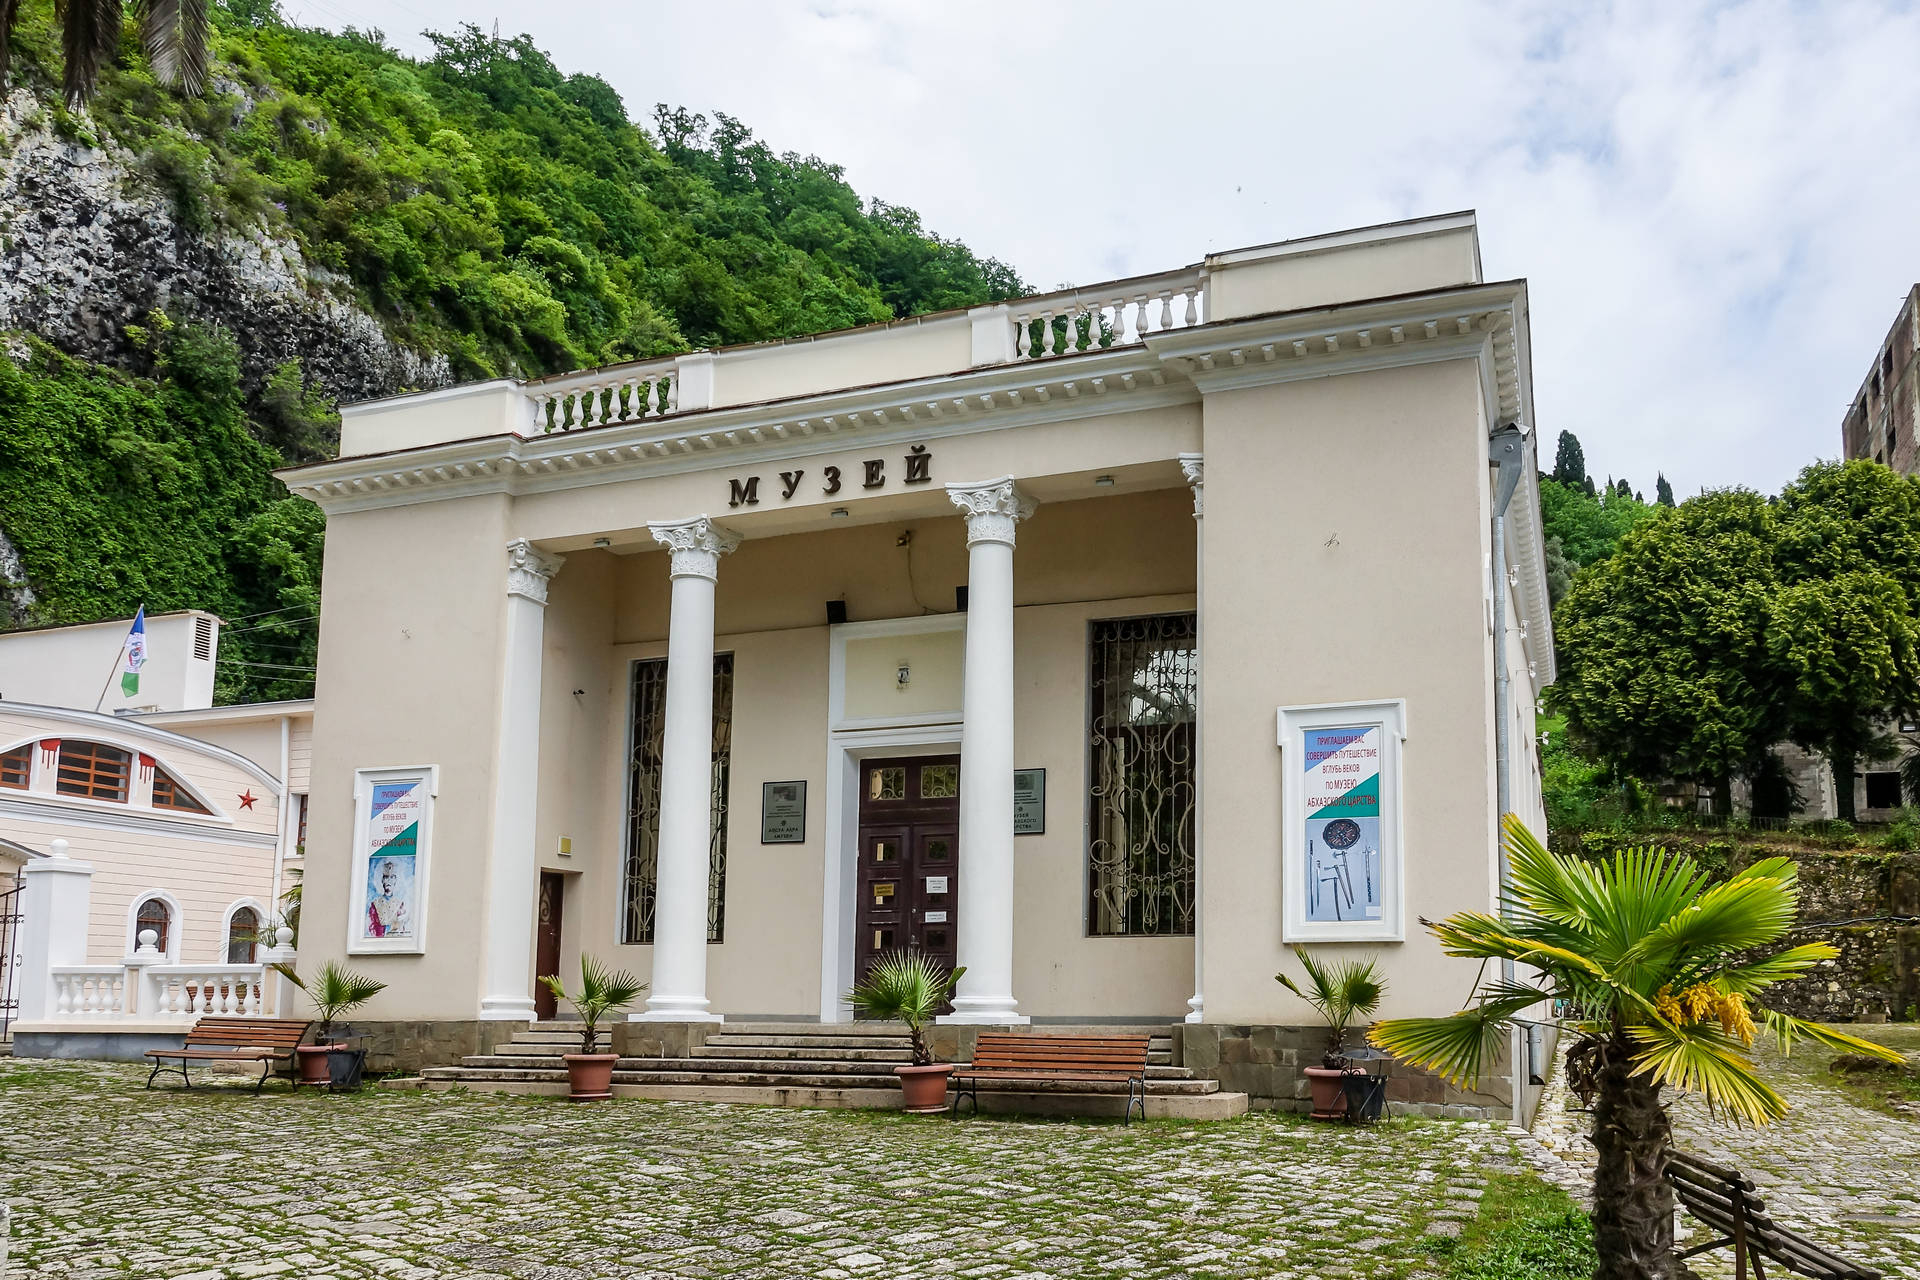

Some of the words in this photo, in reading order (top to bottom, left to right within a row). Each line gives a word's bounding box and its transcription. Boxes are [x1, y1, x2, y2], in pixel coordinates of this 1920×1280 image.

[728, 444, 932, 508] МУЗЕЙ
[1317, 736, 1353, 745] ПРИГЛАШАЕМ
[1354, 735, 1365, 743] ВАС
[1306, 750, 1338, 760] СОВЕРШИТЬ
[1339, 749, 1377, 759] ПУТЕШЕСТВИЕ
[1322, 765, 1342, 774] ВГЛУБЬ
[1343, 764, 1360, 773] ВЕКОВ
[1334, 779, 1357, 790] МУЗЕЮ
[1307, 796, 1347, 807] АБХАЗСКОГО
[1348, 795, 1377, 807] ЦАРСТВА
